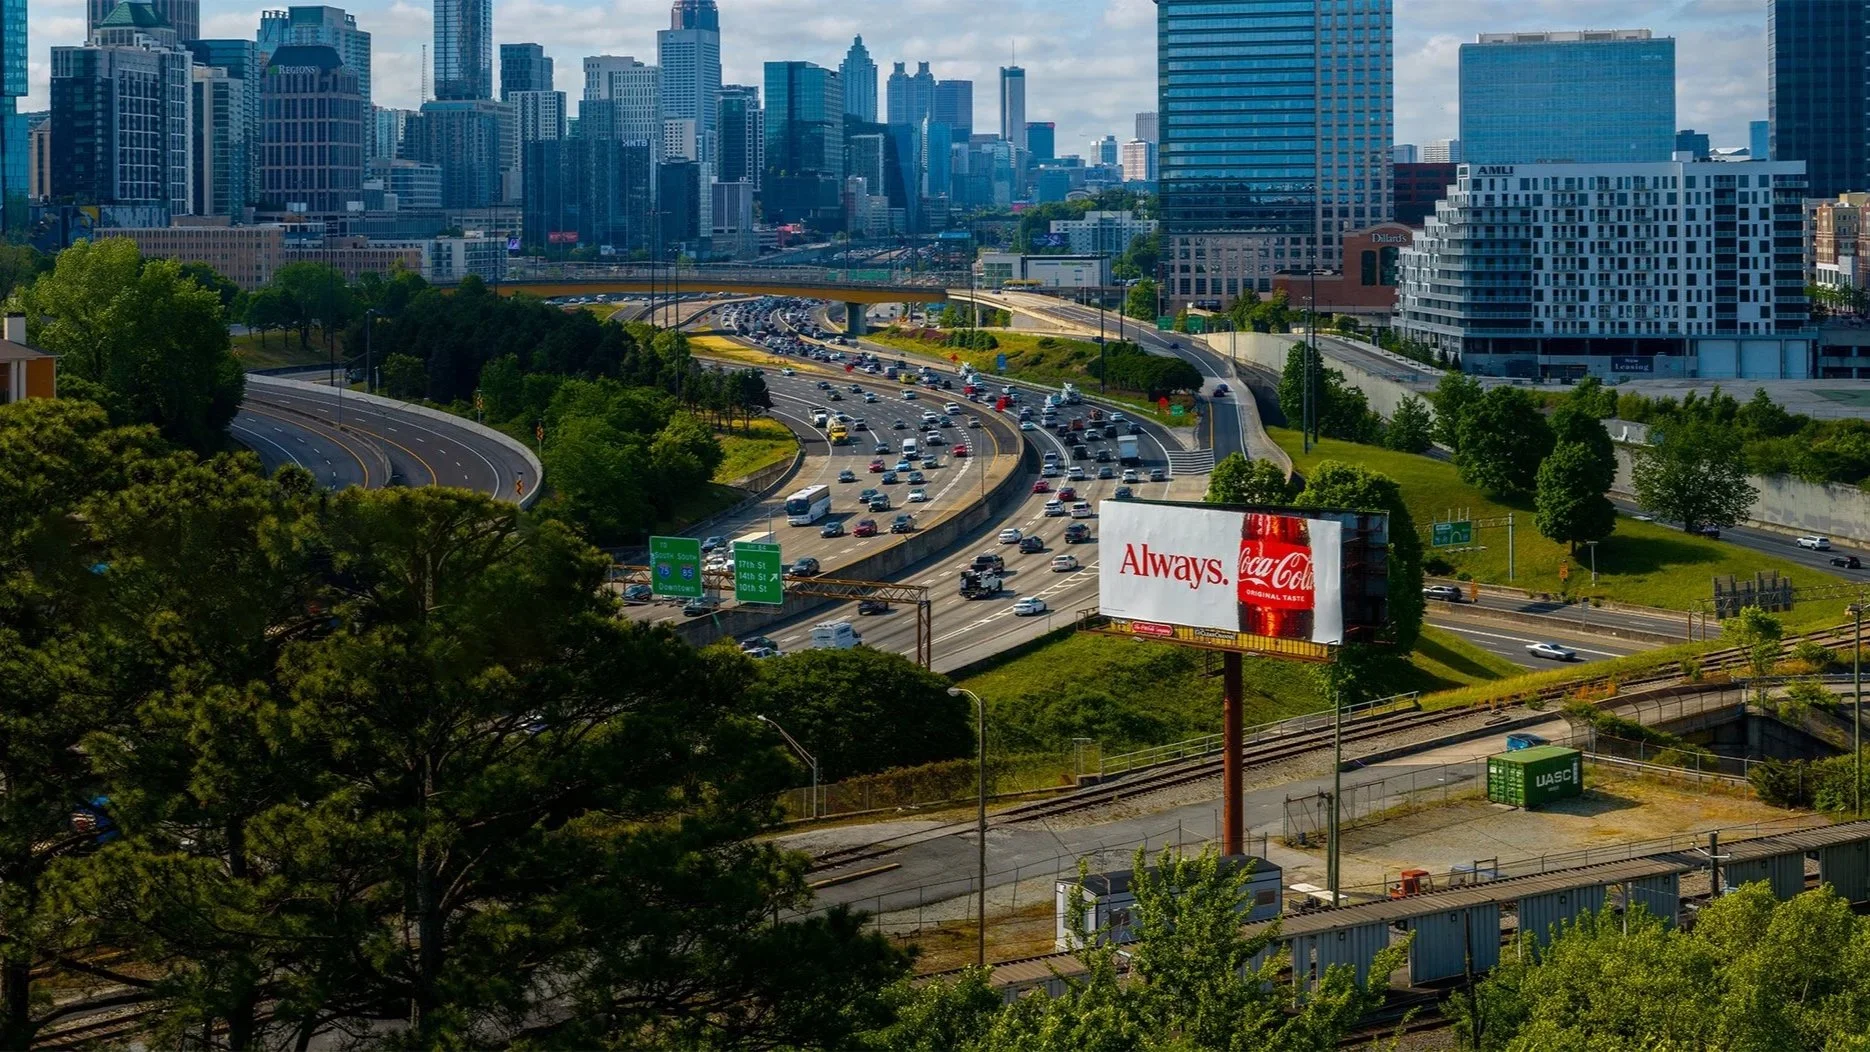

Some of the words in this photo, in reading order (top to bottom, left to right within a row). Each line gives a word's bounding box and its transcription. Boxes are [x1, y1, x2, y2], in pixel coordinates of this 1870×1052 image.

[1477, 166, 1514, 175] AMLI
[1372, 233, 1407, 243] Dillard's
[1615, 363, 1649, 371] Leasing
[738, 560, 755, 569] 17th
[757, 561, 767, 570] St
[1120, 543, 1229, 590] Always.
[1240, 547, 1314, 590] Coca-Cola
[659, 566, 670, 575] 75
[681, 568, 693, 578] 85
[739, 571, 756, 580] 14th
[757, 572, 767, 581] St
[658, 582, 696, 593] Downtown
[739, 583, 757, 592] 10th
[758, 584, 768, 593] St
[1246, 589, 1281, 601] ORIGINAL
[1282, 594, 1305, 602] TASTE
[1536, 769, 1572, 788] UASC
